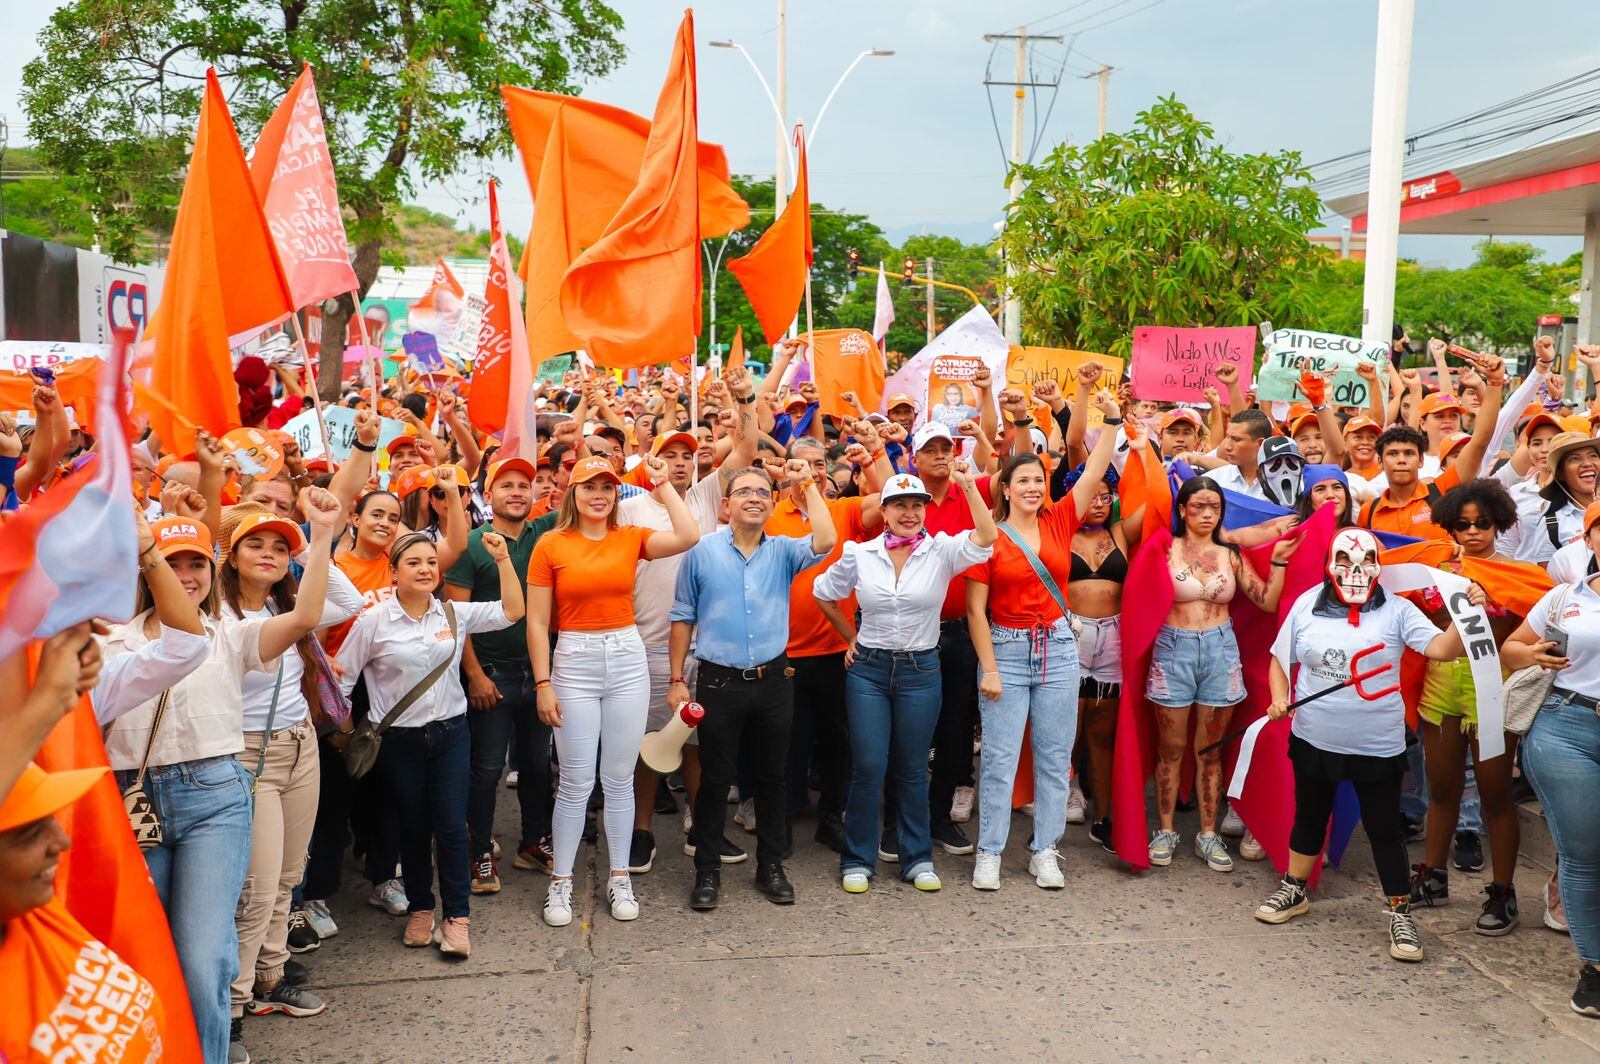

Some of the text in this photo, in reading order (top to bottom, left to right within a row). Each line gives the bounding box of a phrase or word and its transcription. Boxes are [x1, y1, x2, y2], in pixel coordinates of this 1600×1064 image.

[934, 359, 979, 368] PATRICIA
[160, 524, 198, 537] RAFA
[1450, 592, 1496, 661] CNE
